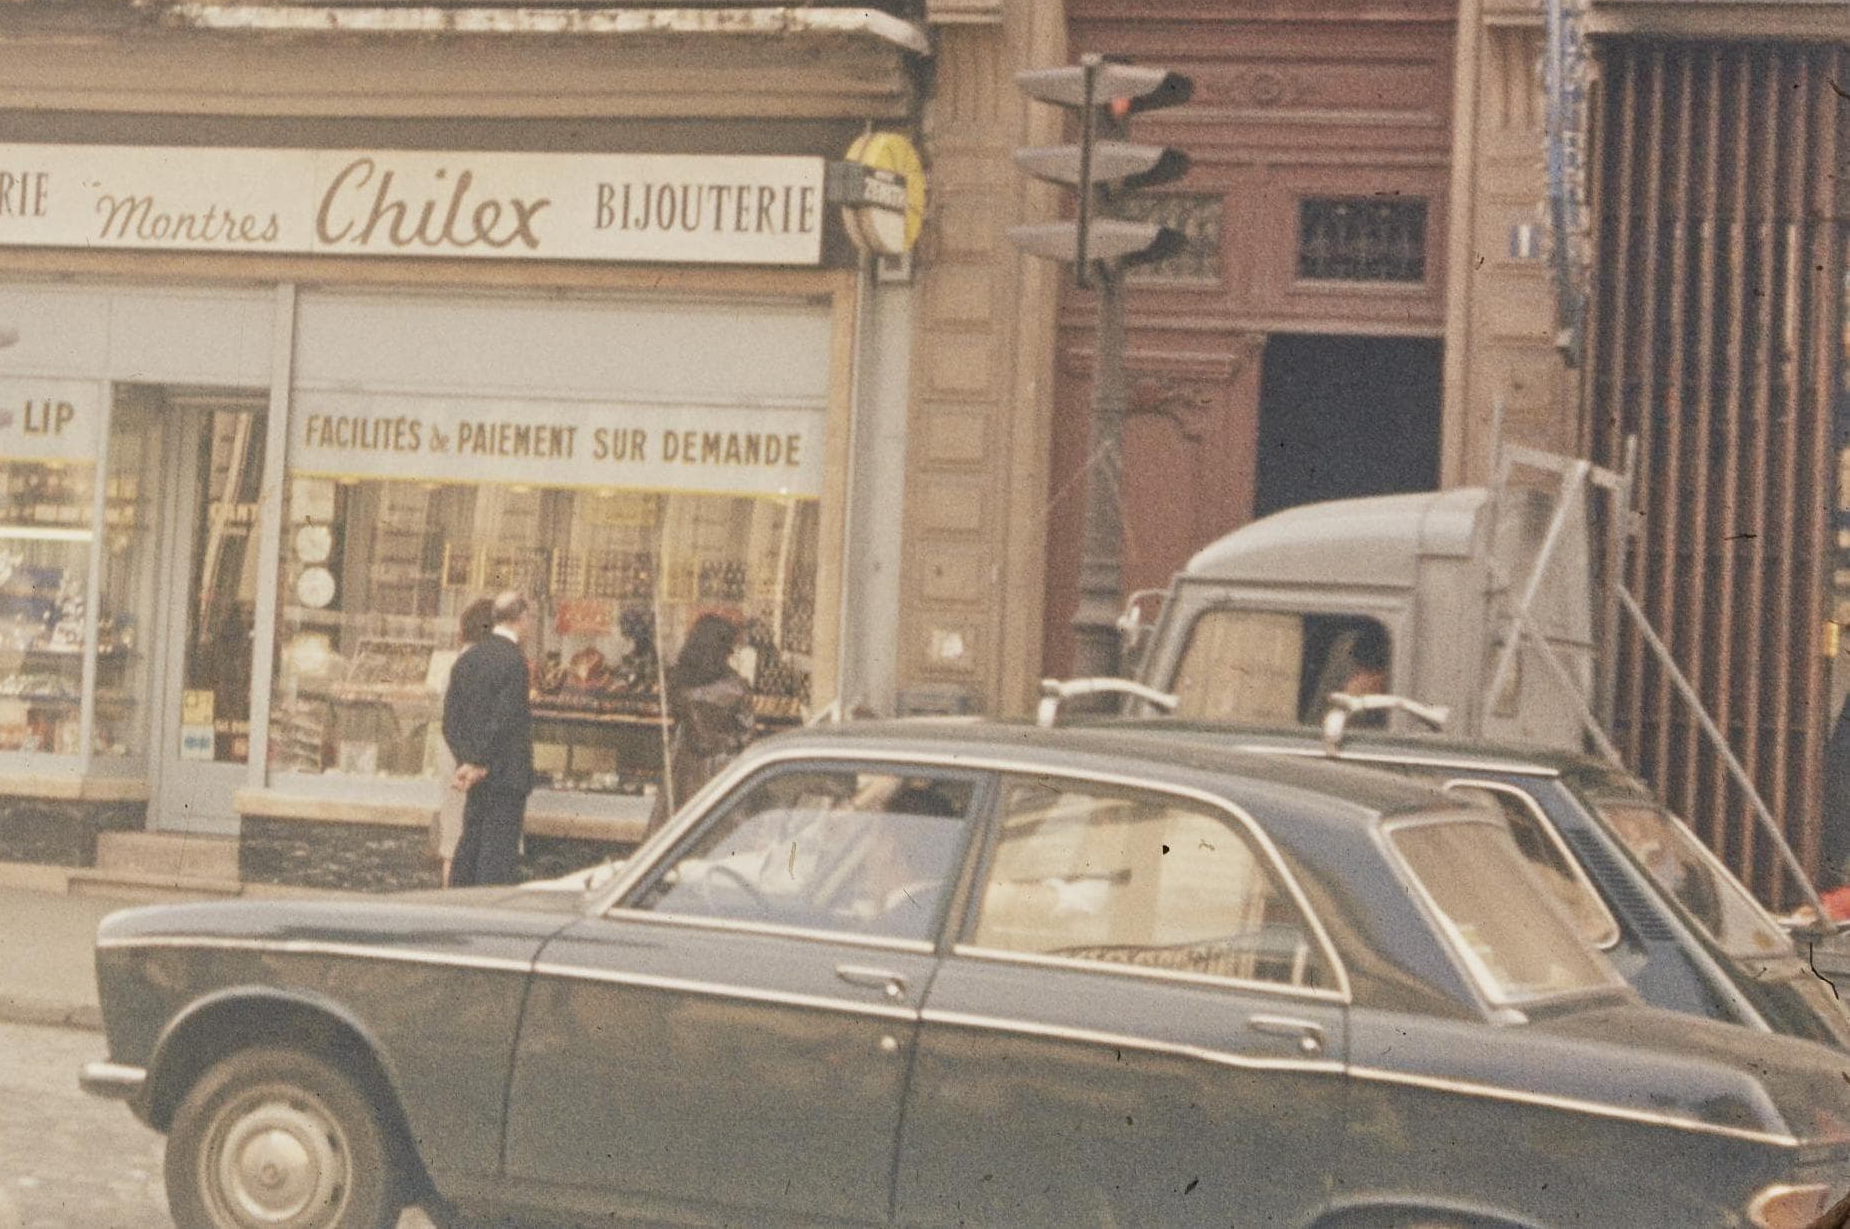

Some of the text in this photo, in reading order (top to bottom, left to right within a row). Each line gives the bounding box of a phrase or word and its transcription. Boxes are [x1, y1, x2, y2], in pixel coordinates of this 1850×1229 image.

[94, 193, 280, 243] Montres
[316, 156, 551, 250] Chilex
[594, 181, 817, 235] BIJOUTERIE
[22, 400, 76, 436] LIP
[305, 413, 422, 454] FACILITÉS
[457, 422, 578, 460] PAIEMENT
[593, 427, 648, 463] SUR
[662, 430, 802, 468] DEMANDE
